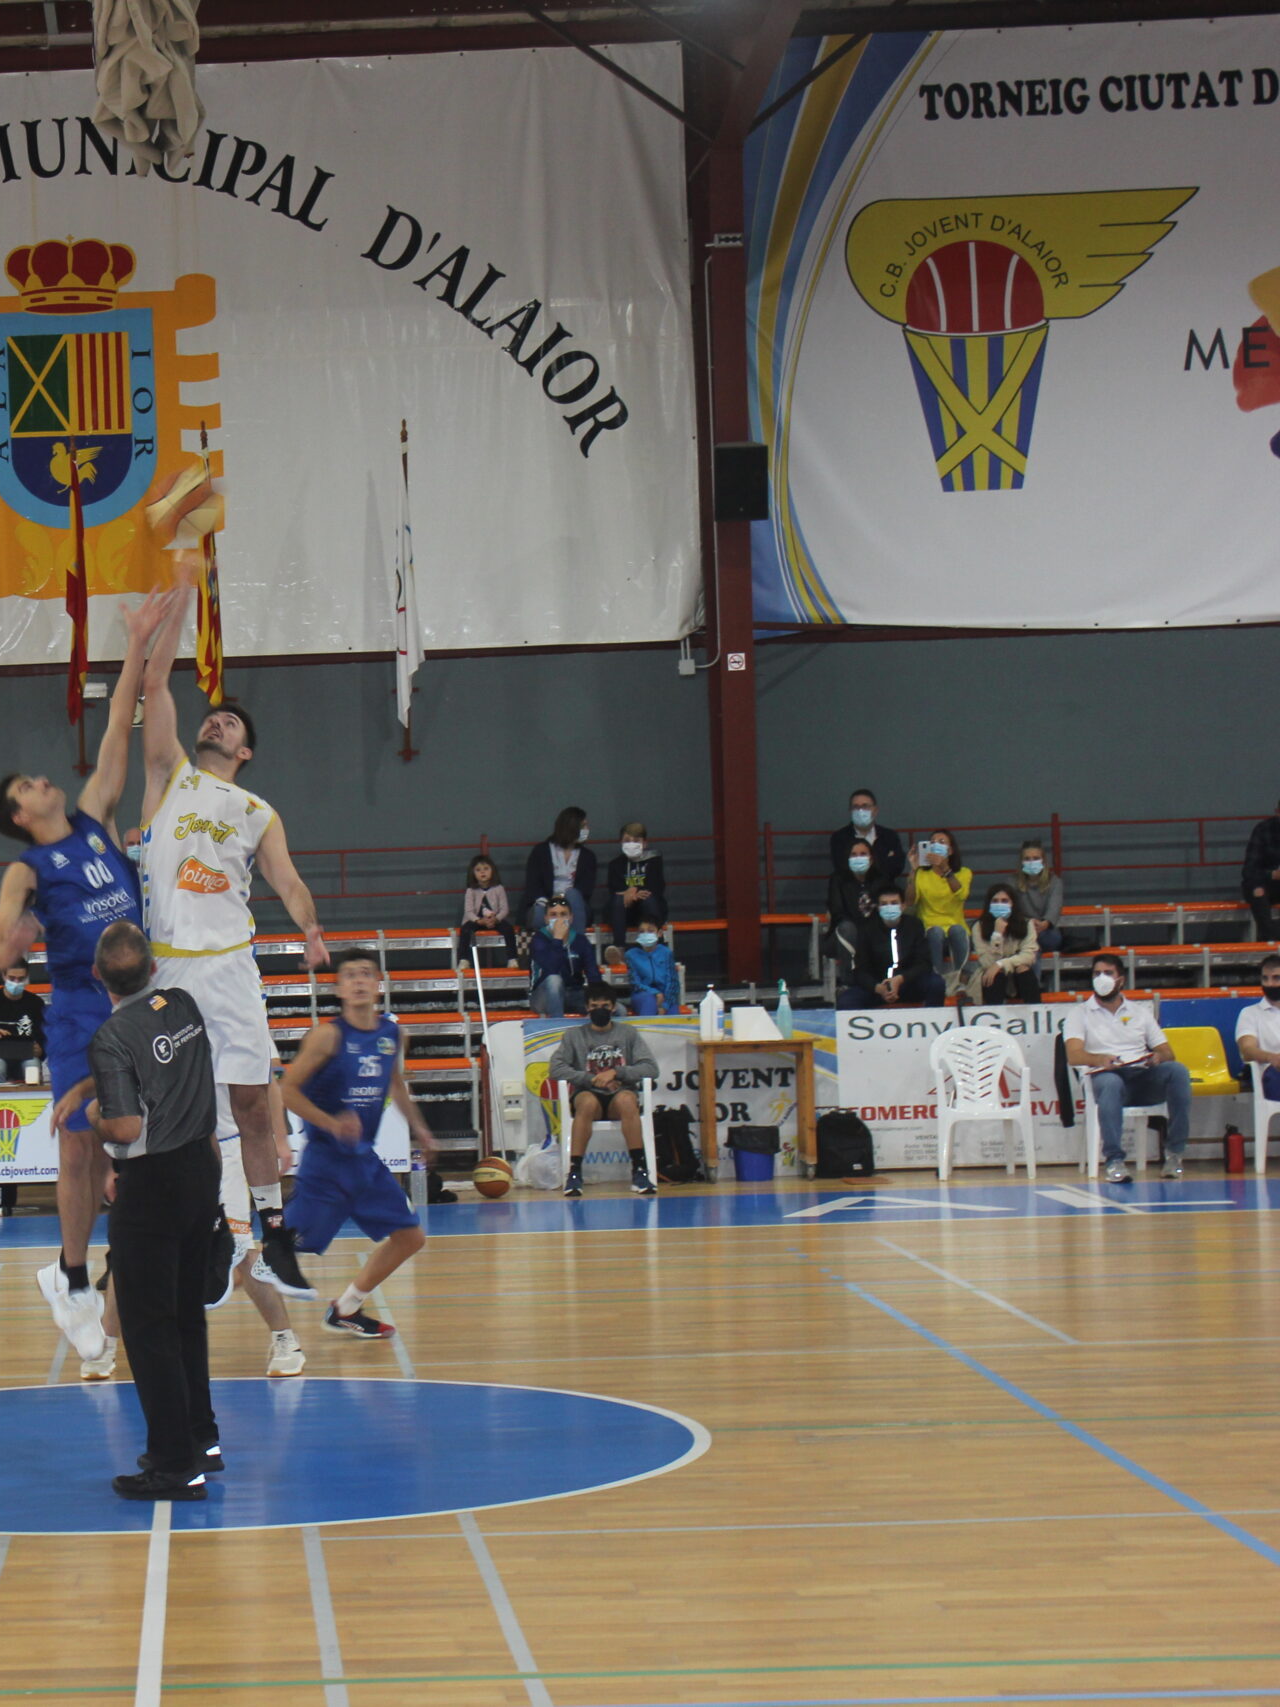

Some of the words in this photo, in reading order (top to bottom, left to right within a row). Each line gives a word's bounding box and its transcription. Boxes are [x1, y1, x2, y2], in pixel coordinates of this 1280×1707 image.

[919, 78, 1090, 121] TORNEIG
[1098, 69, 1243, 113] CIUTAT
[904, 212, 984, 257] JOVENT
[990, 214, 1069, 289] D'ALAIOR
[361, 204, 629, 459] D'ALAIOR
[180, 864, 227, 893] oinga
[846, 1103, 938, 1121] OMERC
